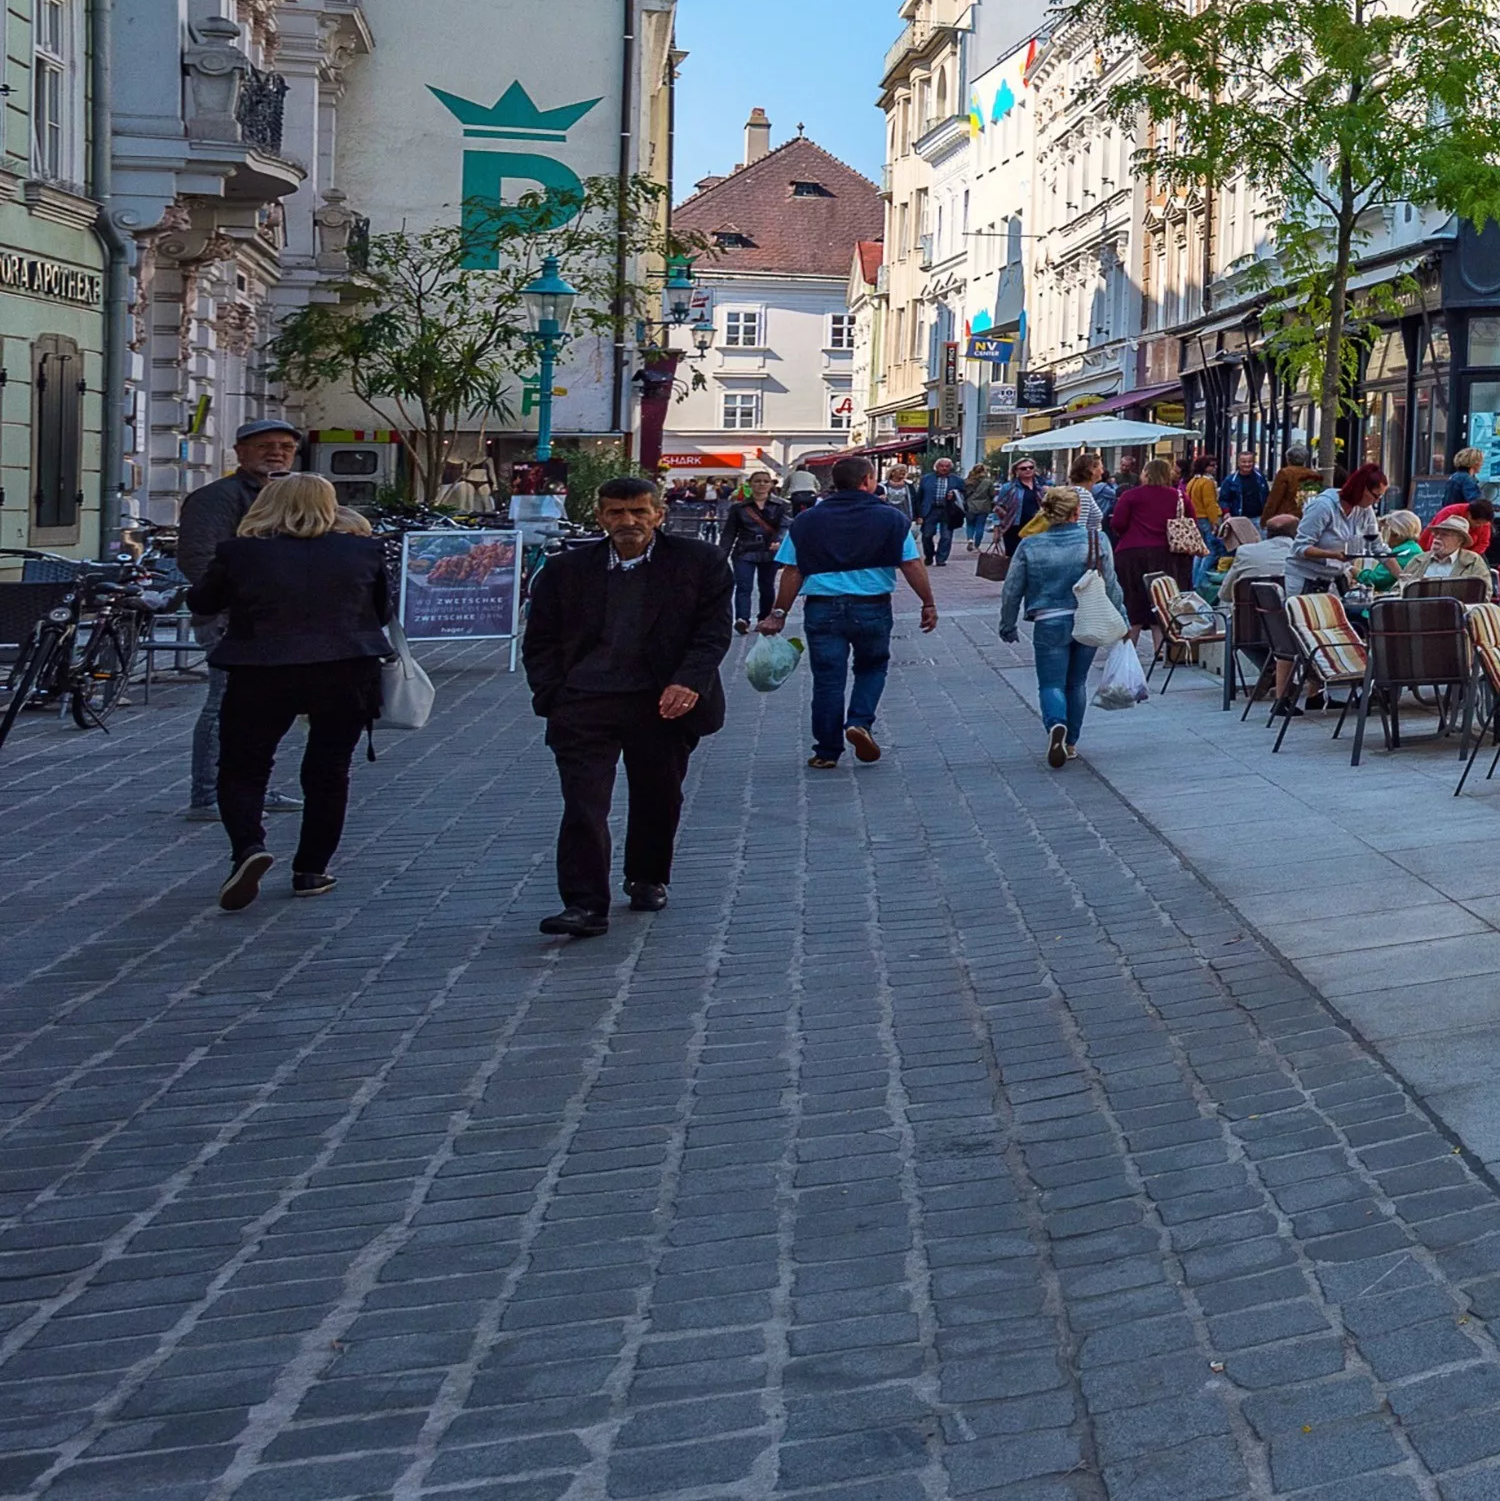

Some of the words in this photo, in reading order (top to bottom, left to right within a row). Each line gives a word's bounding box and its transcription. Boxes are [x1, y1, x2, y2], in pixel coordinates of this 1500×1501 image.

[461, 150, 585, 270] P
[0, 253, 29, 288] ORA
[33, 261, 101, 304] APOTHEKE
[975, 341, 998, 351] NV
[662, 456, 702, 465] SHARK
[436, 597, 503, 605] ZWETSCHKE
[414, 613, 476, 622] ZWETSCHKE
